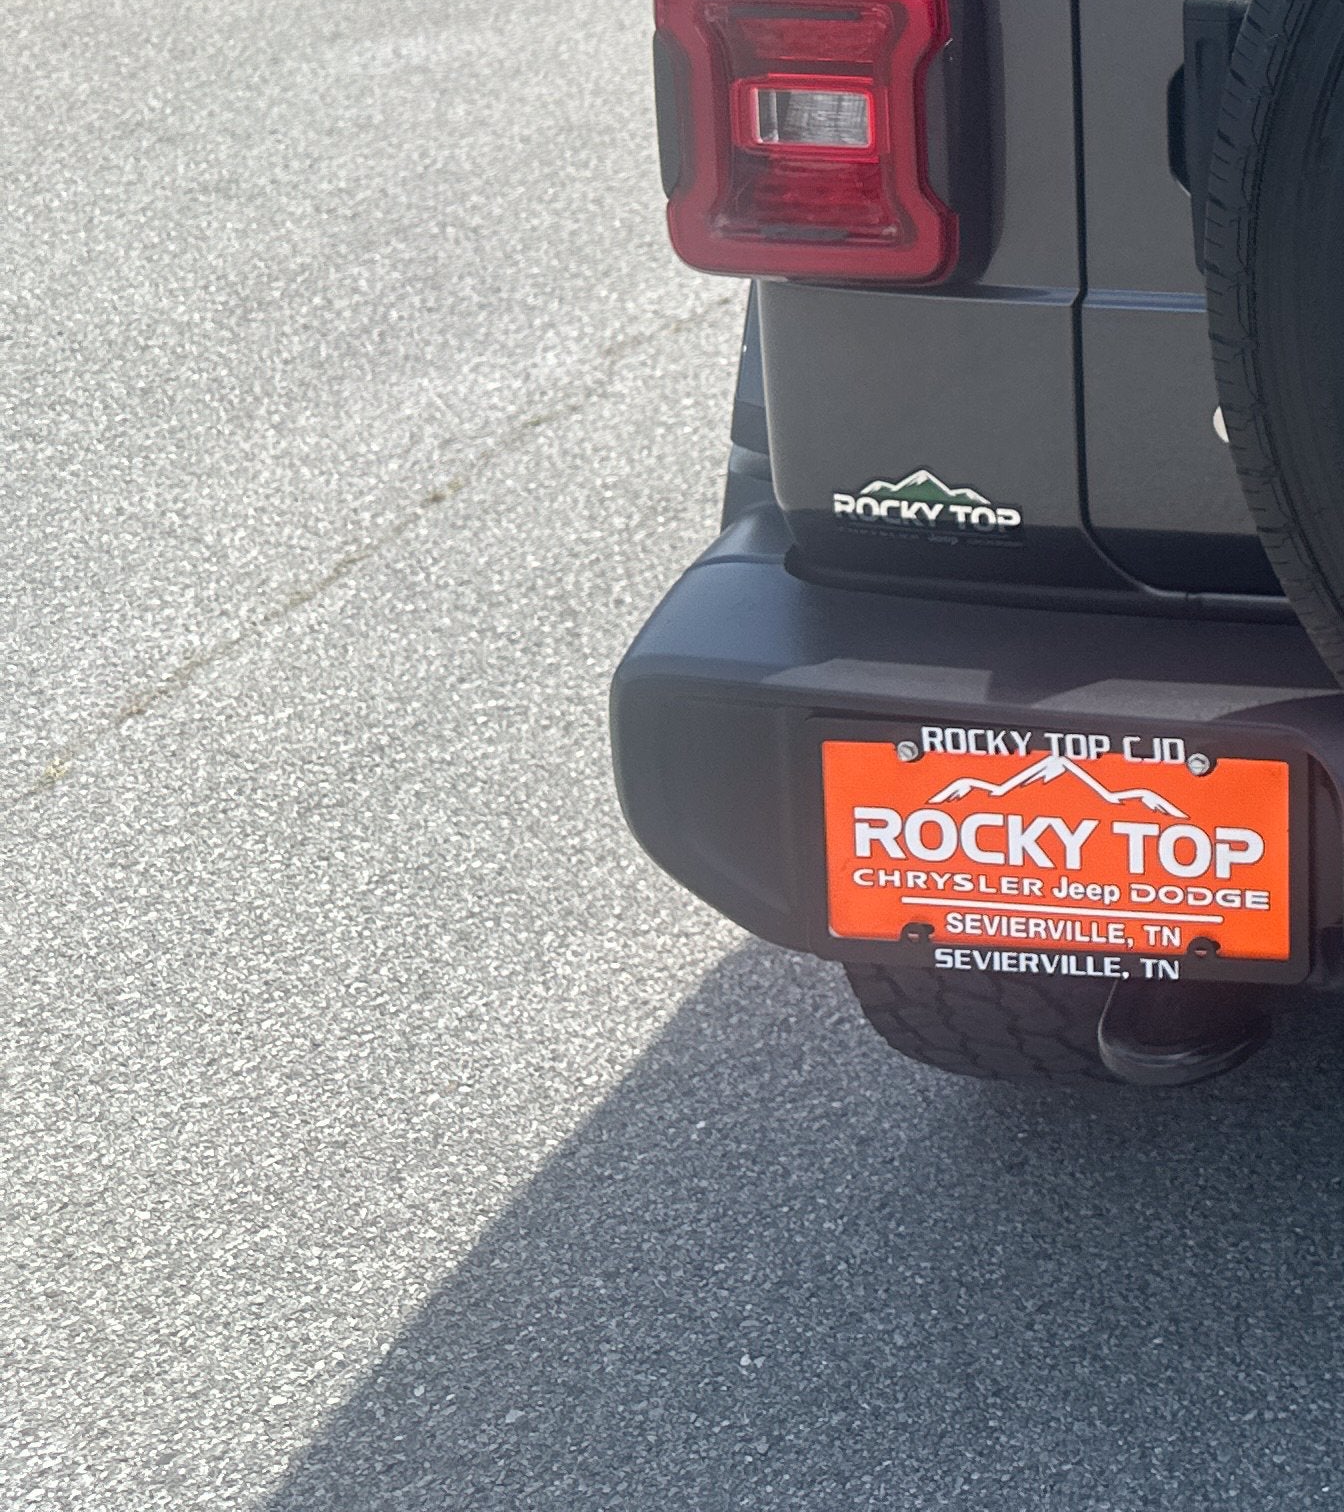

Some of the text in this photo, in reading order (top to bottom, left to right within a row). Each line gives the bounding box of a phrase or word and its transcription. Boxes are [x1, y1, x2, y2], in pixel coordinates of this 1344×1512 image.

[833, 493, 944, 528] ROCKY
[949, 504, 1022, 533] TOP
[921, 725, 1186, 766] ROCKY TOP CJD
[853, 807, 1265, 880] ROCKY TOP
[852, 868, 1270, 911] CHRYSLER Jeep DODGE
[945, 913, 1182, 948] SEVIERVILLE, TN
[934, 949, 1181, 981] SEVIERVILLE, TN
